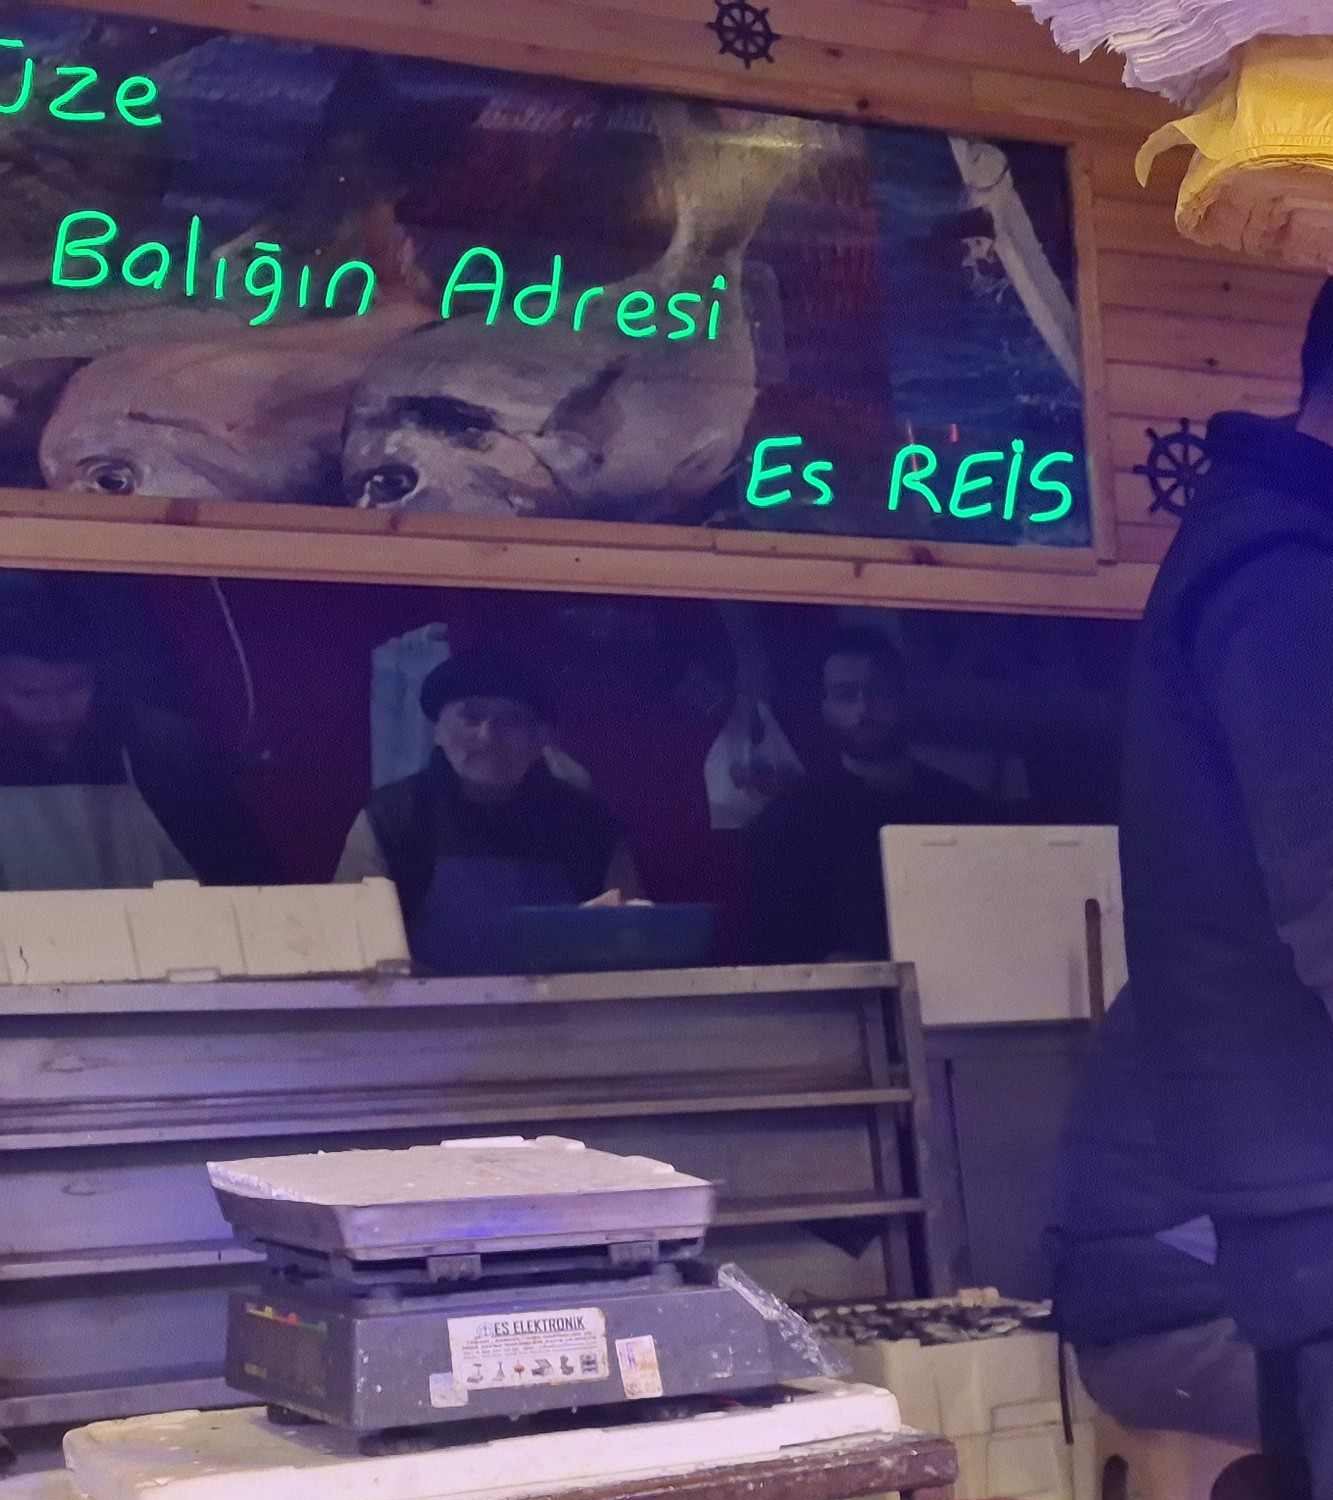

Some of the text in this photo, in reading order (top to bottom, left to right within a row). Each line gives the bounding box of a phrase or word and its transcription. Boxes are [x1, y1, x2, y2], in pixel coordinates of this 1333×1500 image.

[52, 210, 728, 340] Balığın Adresi
[493, 1321, 510, 1336] ES
